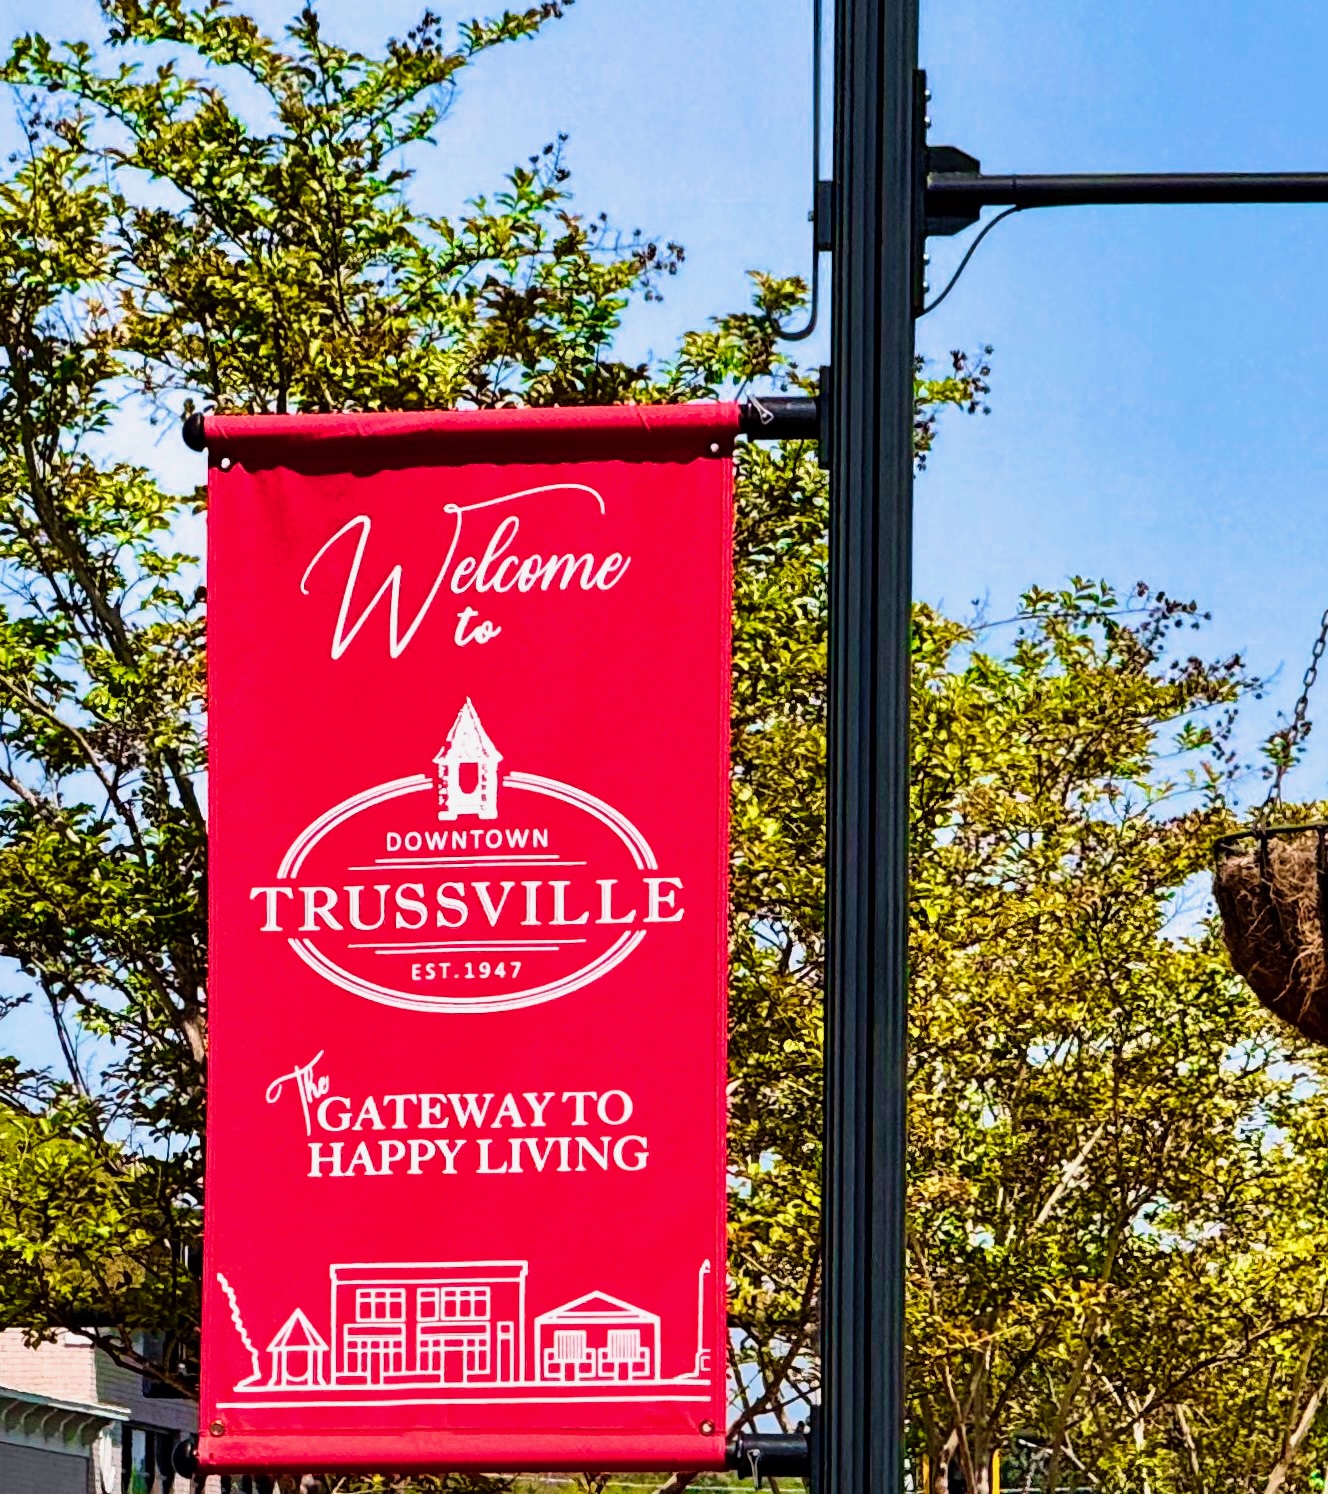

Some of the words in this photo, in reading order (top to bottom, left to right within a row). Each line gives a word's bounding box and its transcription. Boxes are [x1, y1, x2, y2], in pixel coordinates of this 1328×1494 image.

[301, 484, 631, 660] Welcome
[454, 606, 501, 646] to
[387, 828, 548, 852] DOWNTOWN
[249, 877, 685, 932] TRUSSVILLE
[266, 1050, 329, 1136] The
[317, 1092, 556, 1131] GATEWAY
[560, 1089, 634, 1126] TO
[308, 1138, 466, 1177] HAPPY
[476, 1135, 649, 1173] LIVING
